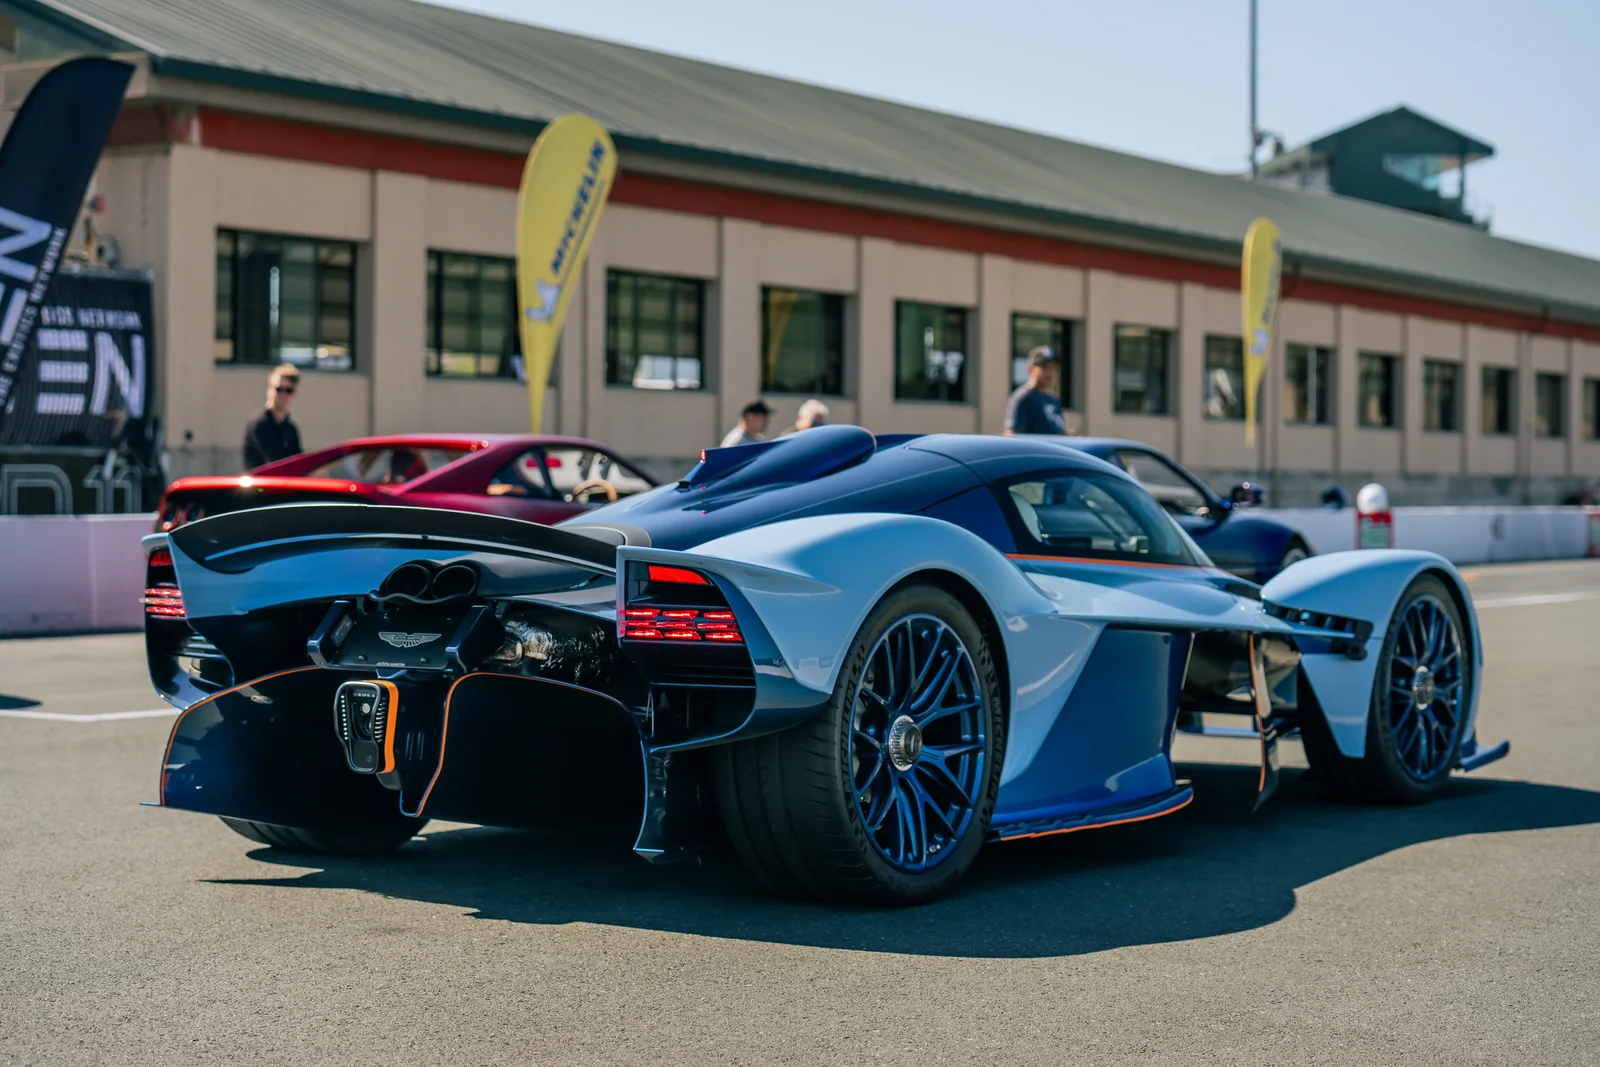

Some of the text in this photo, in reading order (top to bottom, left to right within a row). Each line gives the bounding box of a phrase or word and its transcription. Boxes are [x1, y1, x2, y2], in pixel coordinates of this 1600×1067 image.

[551, 140, 604, 275] MICHELIN
[2, 305, 38, 373] EXOTICS
[29, 227, 68, 304] NETWORK
[842, 680, 856, 793] MICHELIN
[989, 696, 1003, 800] MICHELIN
